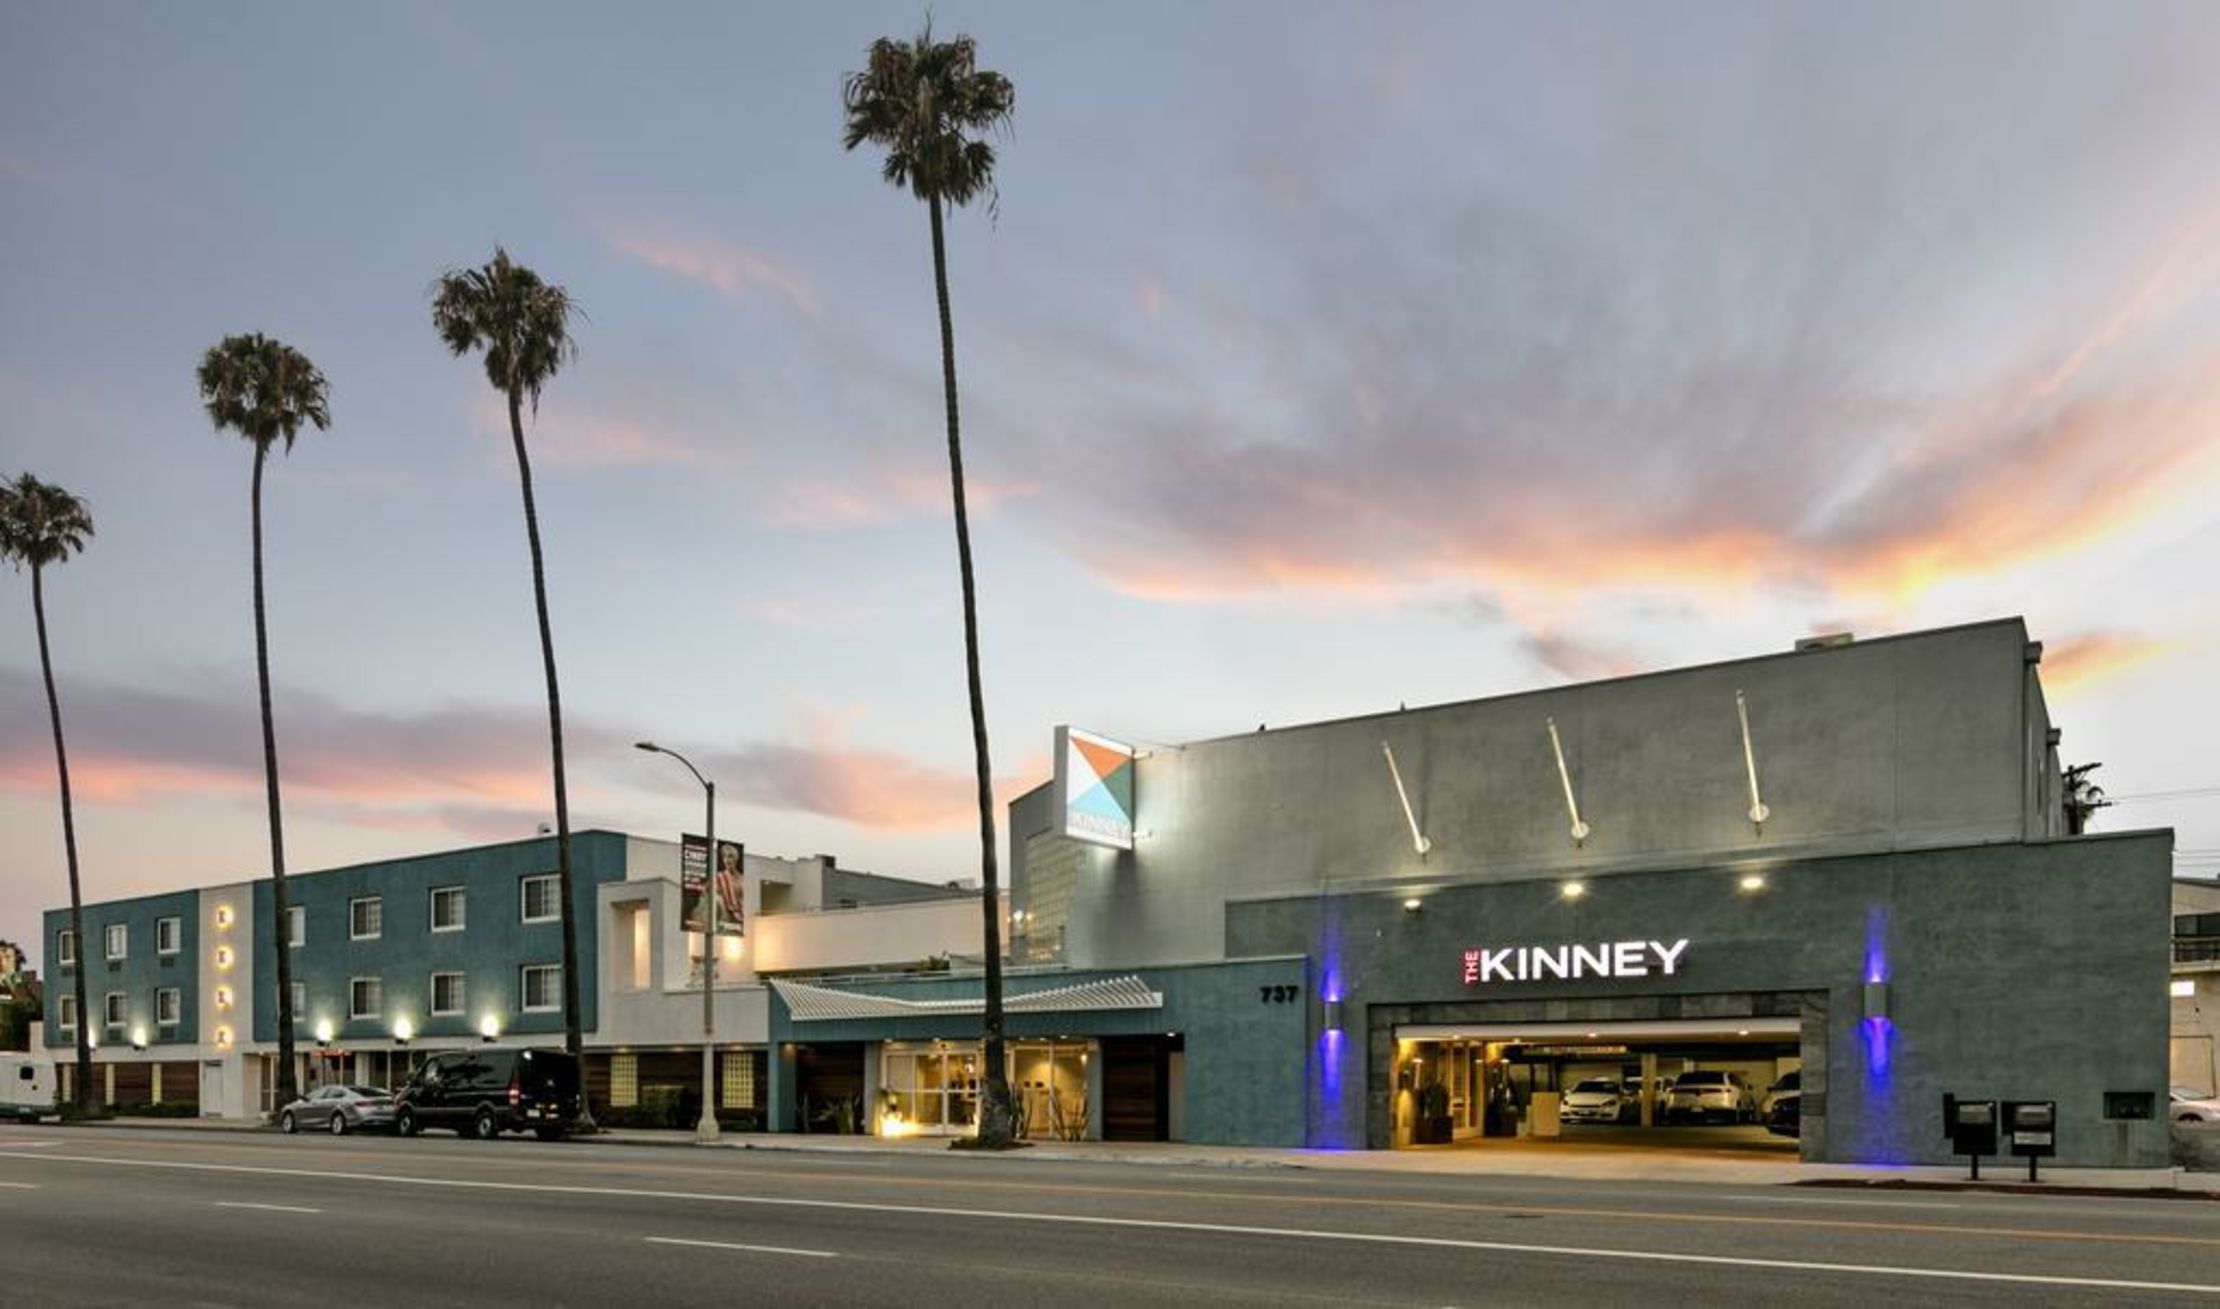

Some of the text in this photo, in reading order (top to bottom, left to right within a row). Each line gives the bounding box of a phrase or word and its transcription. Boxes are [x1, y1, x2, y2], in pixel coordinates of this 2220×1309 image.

[1464, 939, 1689, 983] THE KINNEY
[1259, 985, 1298, 1004] 737
